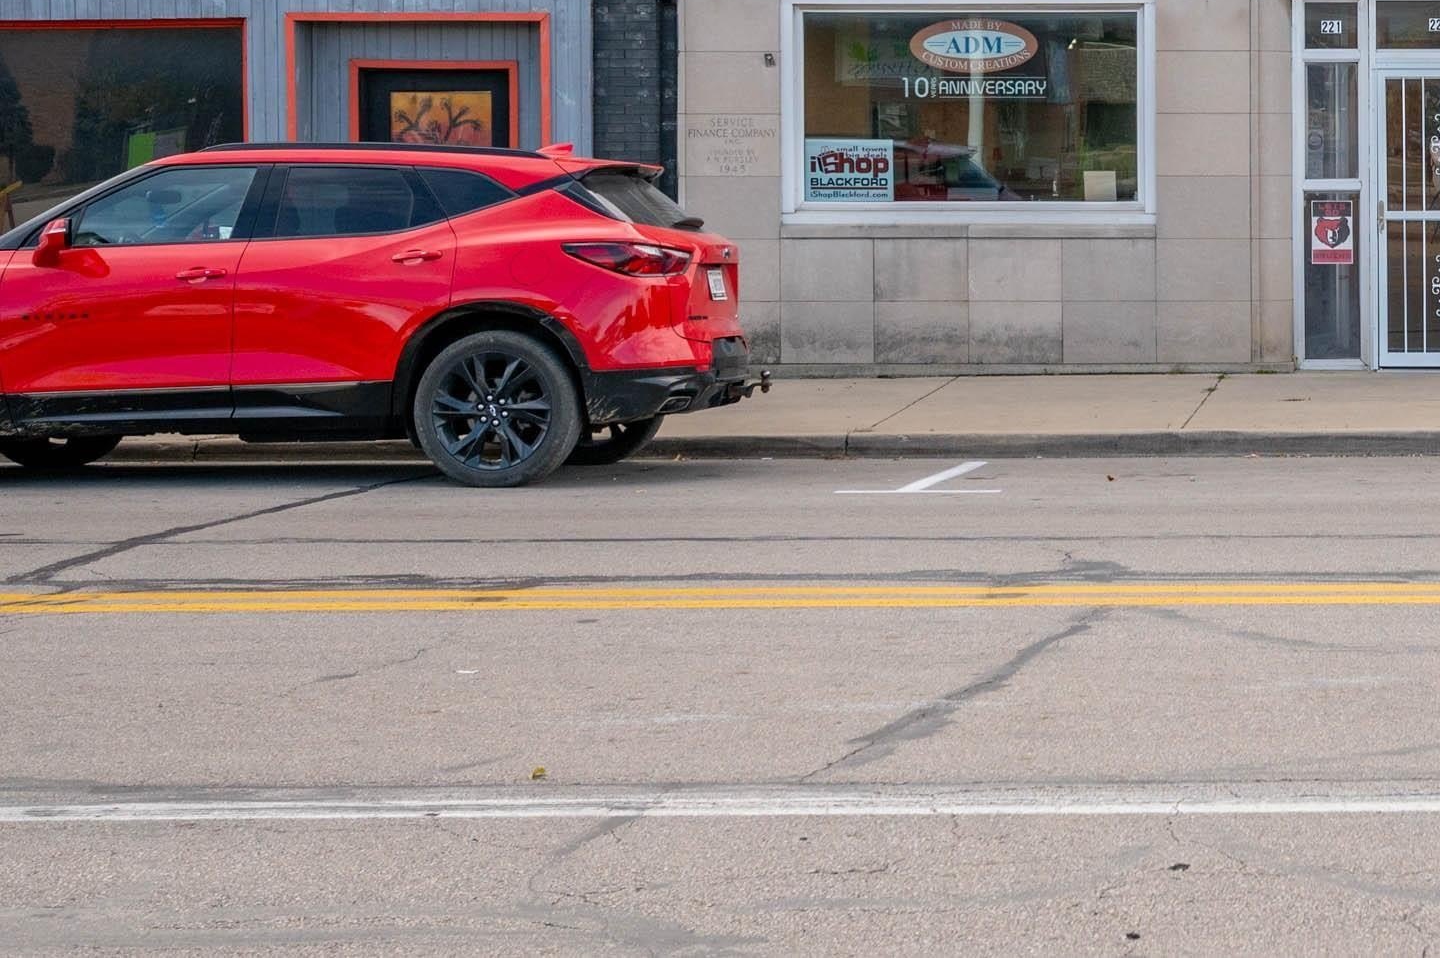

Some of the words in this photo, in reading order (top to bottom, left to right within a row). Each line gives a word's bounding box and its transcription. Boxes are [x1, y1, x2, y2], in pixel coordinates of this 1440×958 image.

[952, 21, 984, 30] MADE
[987, 22, 1002, 31] BY
[1321, 21, 1340, 33] 221
[946, 36, 1003, 54] ADM
[922, 51, 968, 70] CUSTOM
[970, 49, 1031, 70] CREATIONS
[902, 77, 929, 98] 10
[939, 80, 1047, 95] ANNIVERSARY
[711, 117, 754, 127] SERVICE
[687, 129, 729, 138] FINANCE
[731, 129, 777, 138] COMPANY
[810, 150, 889, 178] iShop
[810, 177, 888, 186] BLACKFORD
[810, 191, 889, 199] iShopBlackford.com
